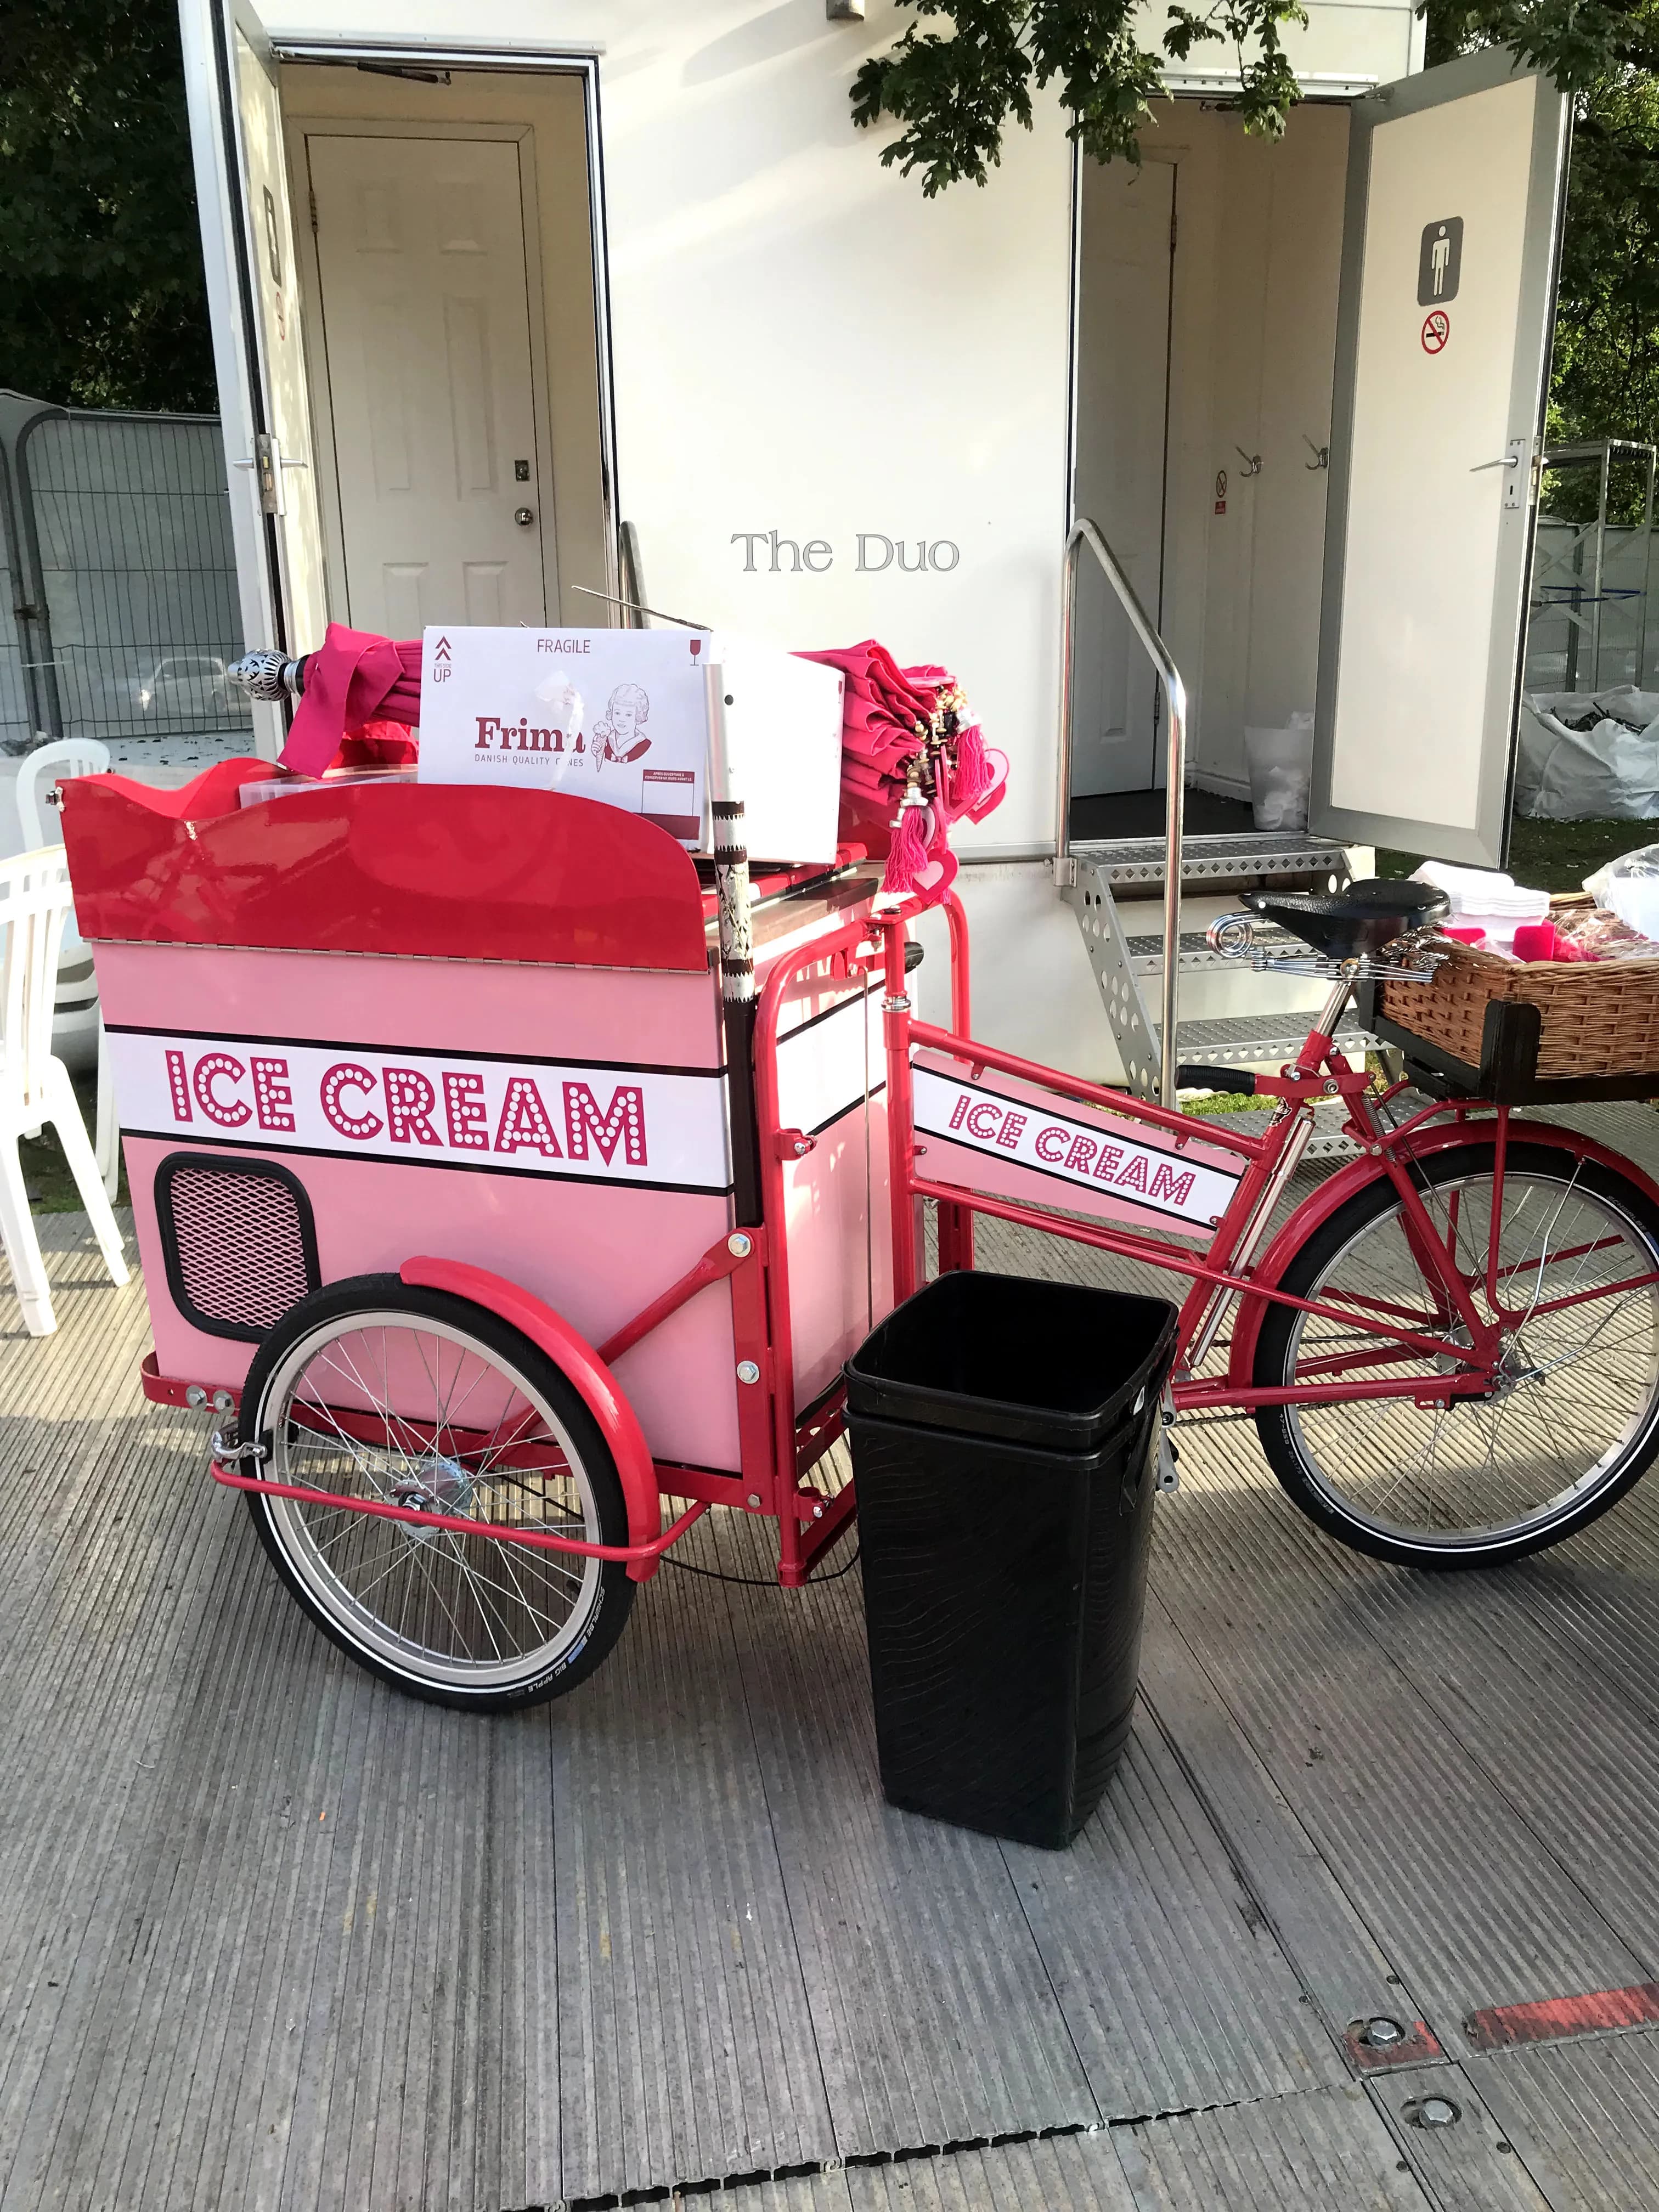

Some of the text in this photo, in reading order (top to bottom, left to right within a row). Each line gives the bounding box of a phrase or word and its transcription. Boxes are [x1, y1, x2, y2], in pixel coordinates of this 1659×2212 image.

[730, 529, 960, 573] The Duo
[538, 639, 591, 653] FRAGILE
[433, 668, 452, 682] UP
[475, 754, 584, 767] DANISH QUALITY CNES
[165, 1050, 647, 1166] ICE CREAM
[949, 1094, 1196, 1206] ICE CREAM
[528, 1585, 605, 1693] SCHWALBE BIG APPLE
